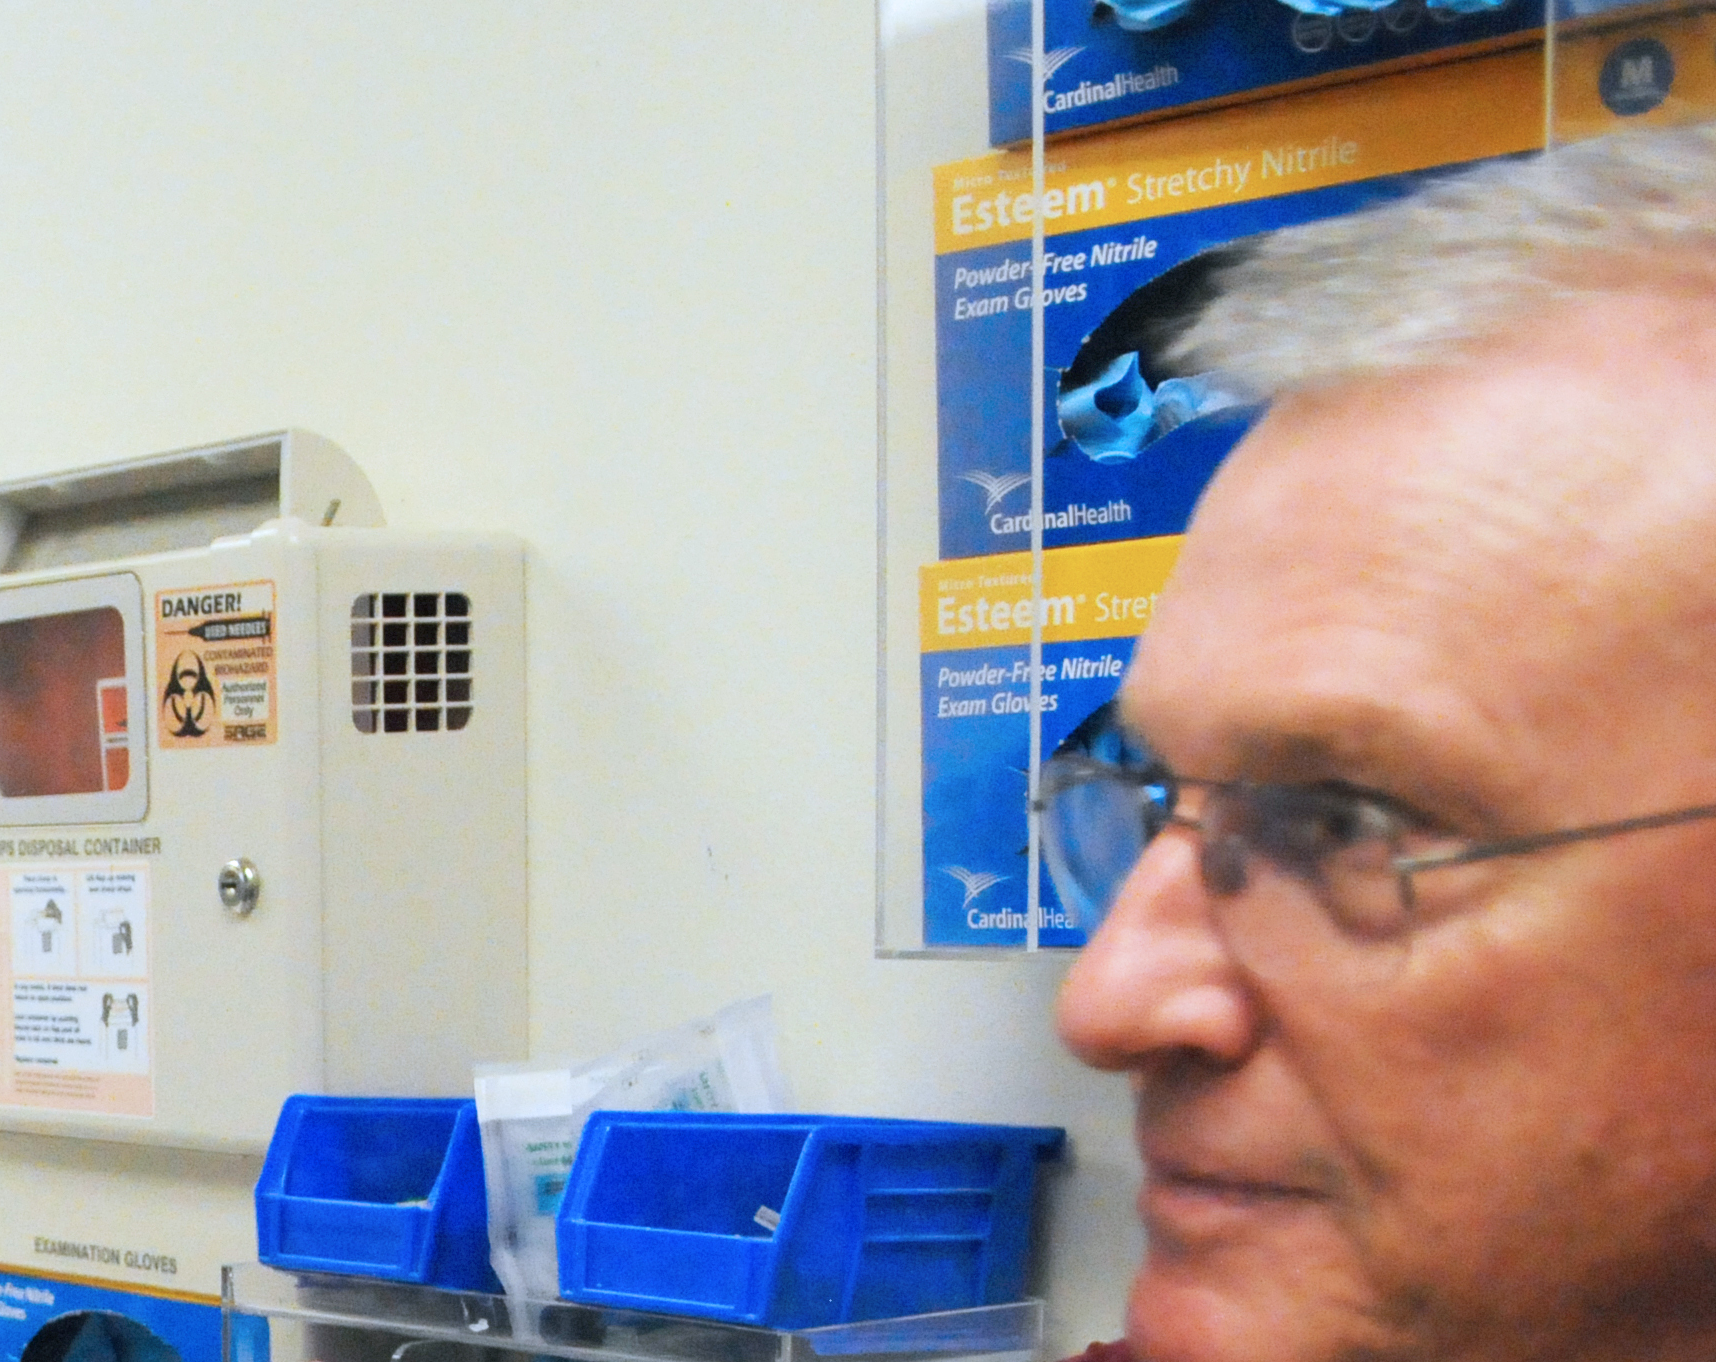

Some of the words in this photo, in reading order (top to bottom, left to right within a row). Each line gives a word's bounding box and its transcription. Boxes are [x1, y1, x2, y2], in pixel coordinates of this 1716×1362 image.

[1126, 158, 1251, 204] Stretchy
[1261, 136, 1358, 179] Nitrile
[954, 252, 1085, 289] Powder-Free
[1090, 236, 1157, 267] Nitrile
[954, 294, 1009, 320] Exam
[1014, 283, 1087, 309] Goves
[990, 499, 1132, 535] CardnalHealth
[161, 592, 242, 618] DANGER!
[1094, 592, 1158, 622] Stret
[229, 621, 267, 636] NEEDLES
[1060, 654, 1122, 680] Nitrile
[937, 695, 986, 719] Exam
[18, 839, 79, 857] DISPOSAL
[84, 837, 162, 855] CONTAINER
[34, 1236, 121, 1265] EXAMINATION
[124, 1251, 178, 1275] GLOVES
